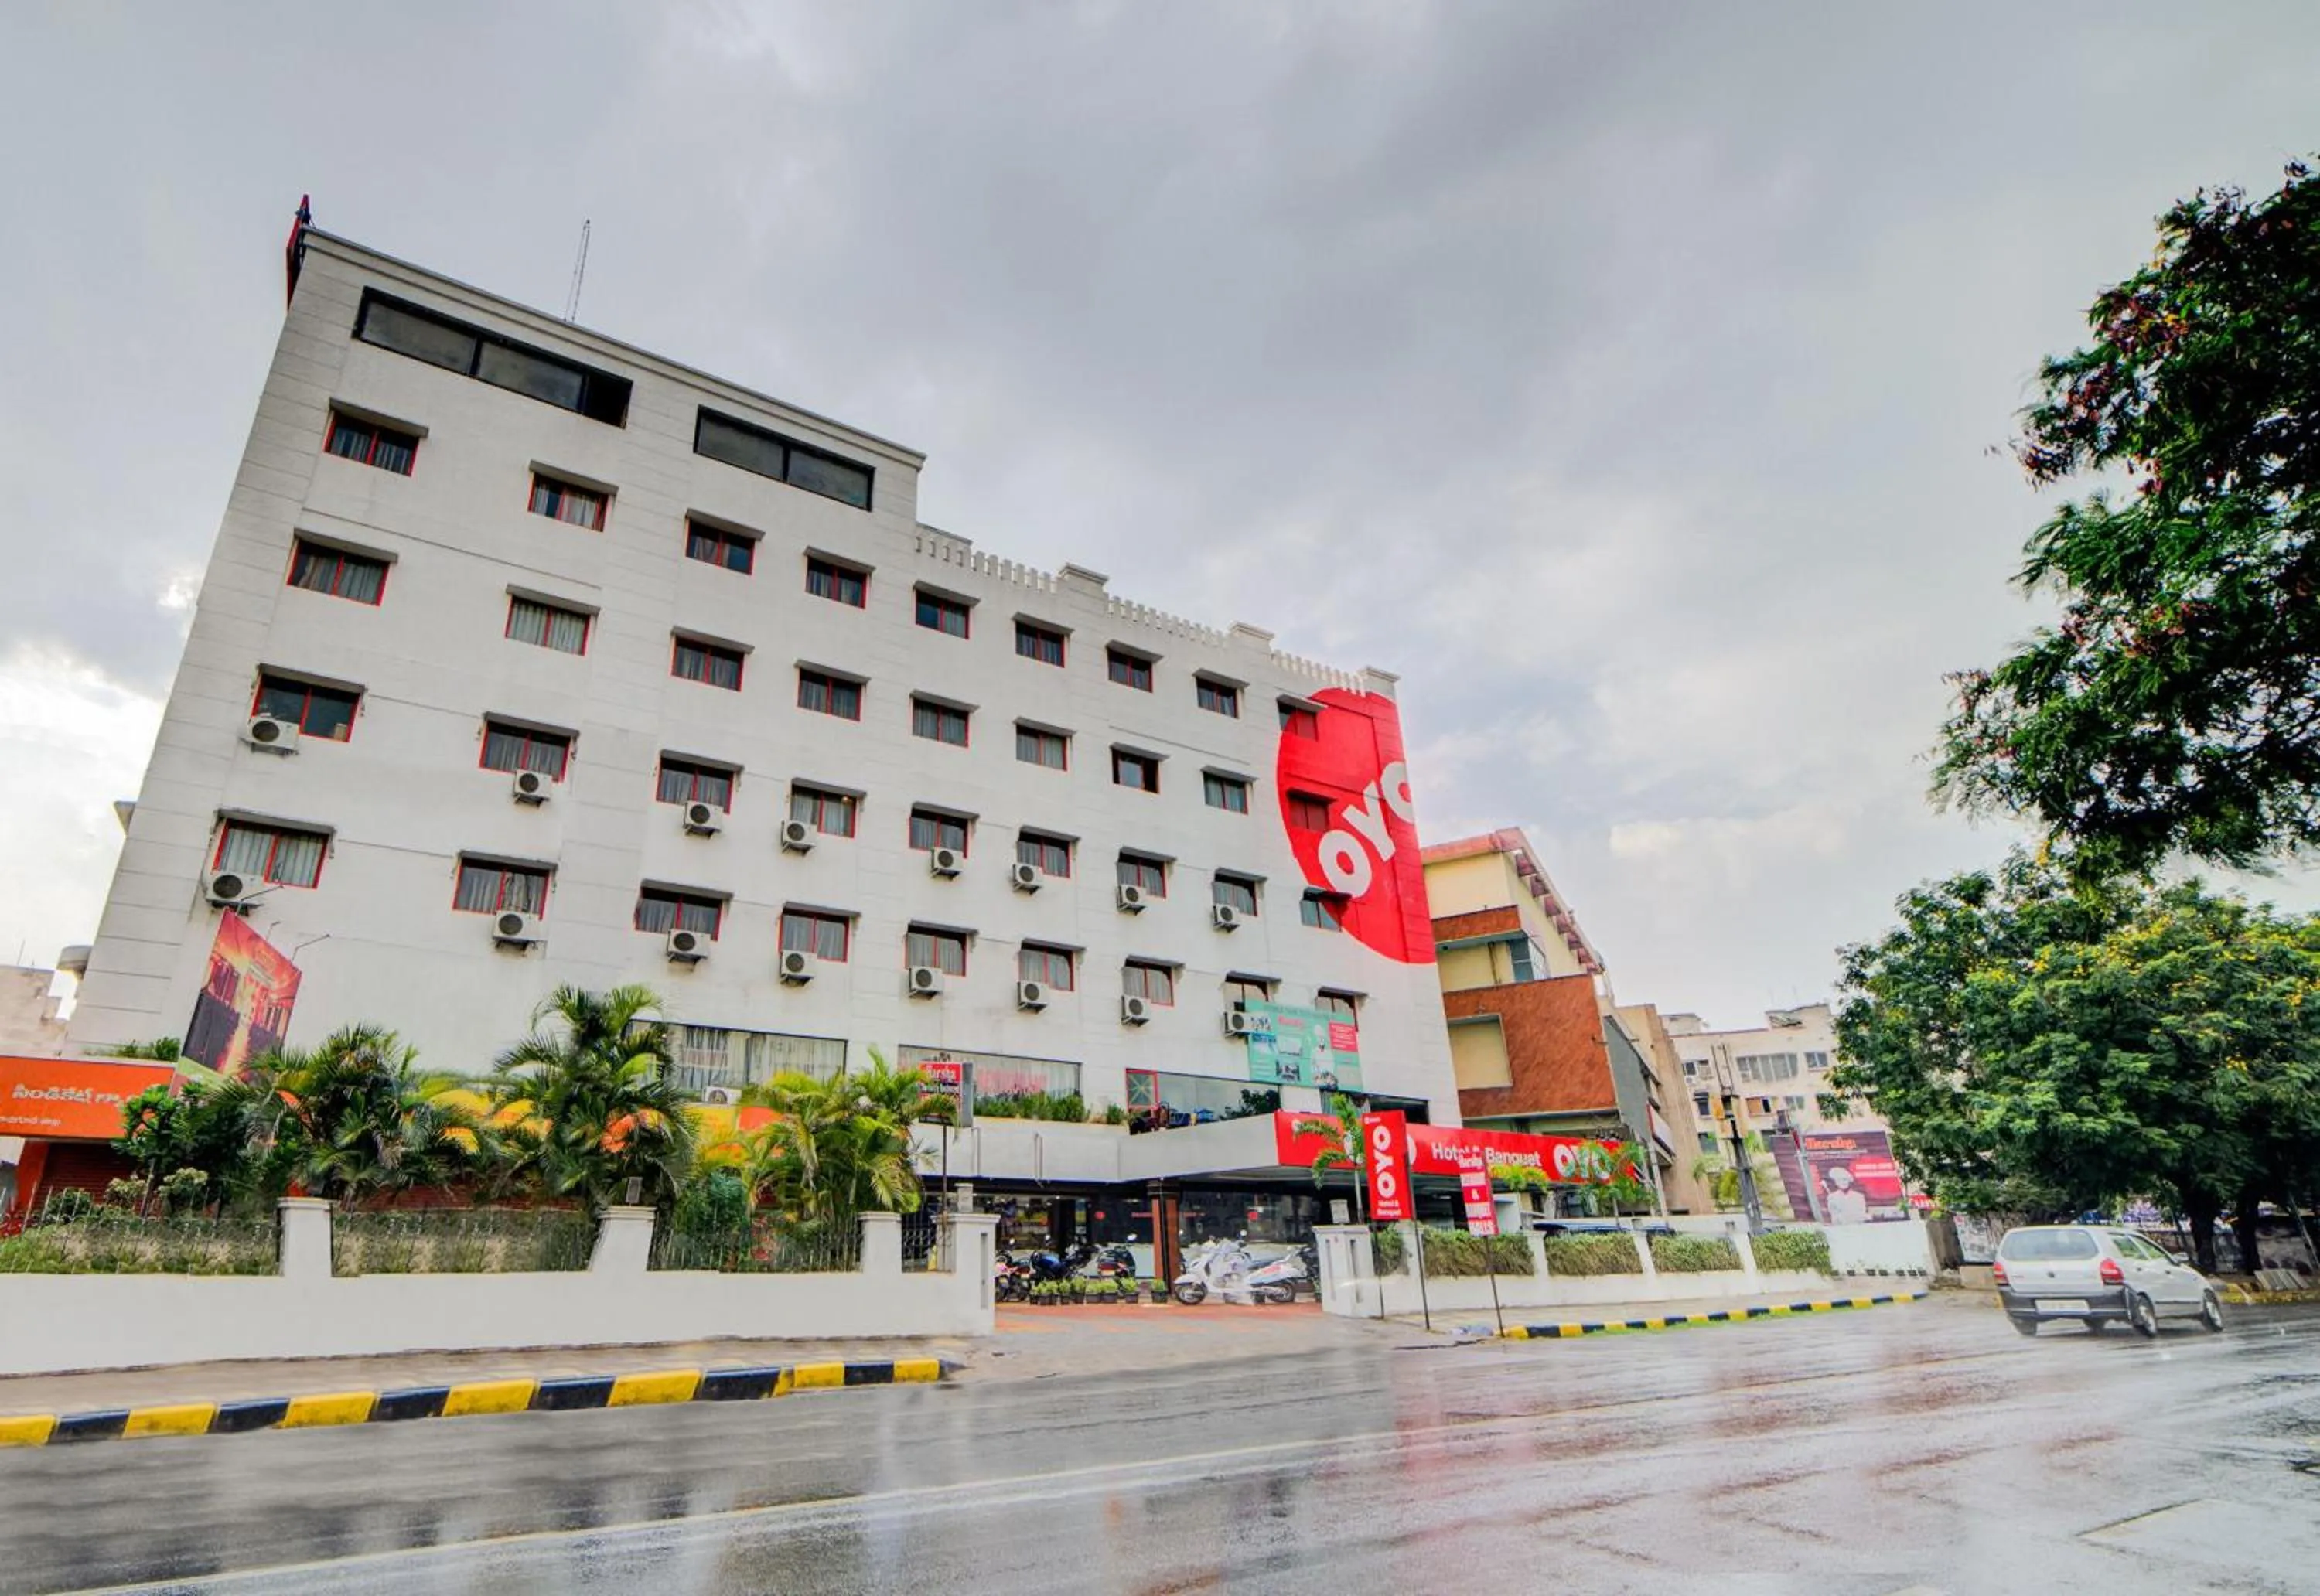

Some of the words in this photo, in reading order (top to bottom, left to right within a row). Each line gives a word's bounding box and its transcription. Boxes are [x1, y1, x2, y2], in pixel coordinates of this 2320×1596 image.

[1319, 761, 1415, 898] OYO
[1373, 1125, 1396, 1199] OYO
[1553, 1144, 1612, 1180] OYO
